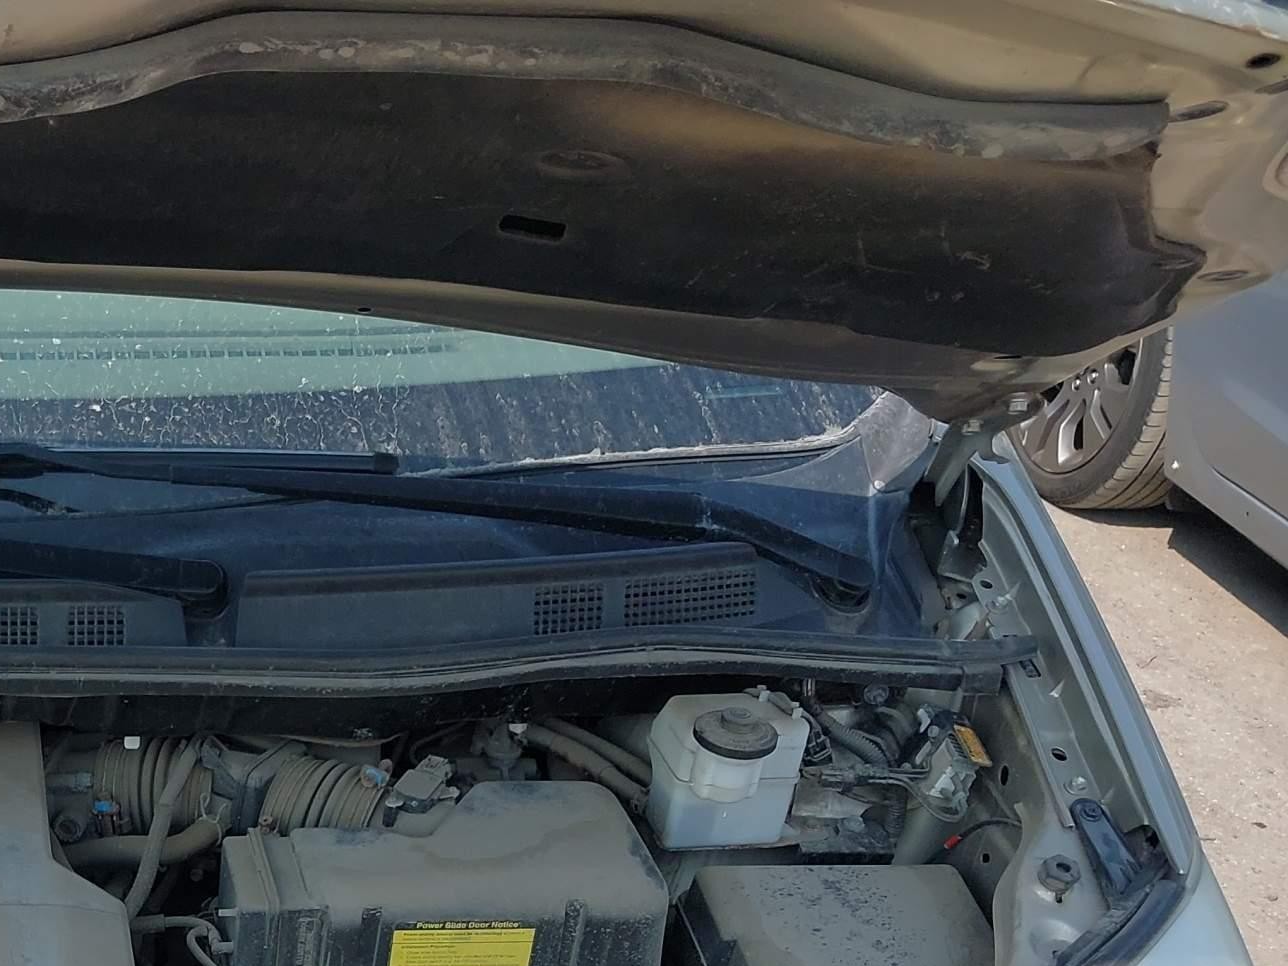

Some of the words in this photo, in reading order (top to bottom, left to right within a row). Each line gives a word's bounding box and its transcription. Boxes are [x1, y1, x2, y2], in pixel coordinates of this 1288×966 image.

[416, 921, 443, 929] Power
[468, 921, 490, 929] Door
[491, 920, 520, 928] Notice
